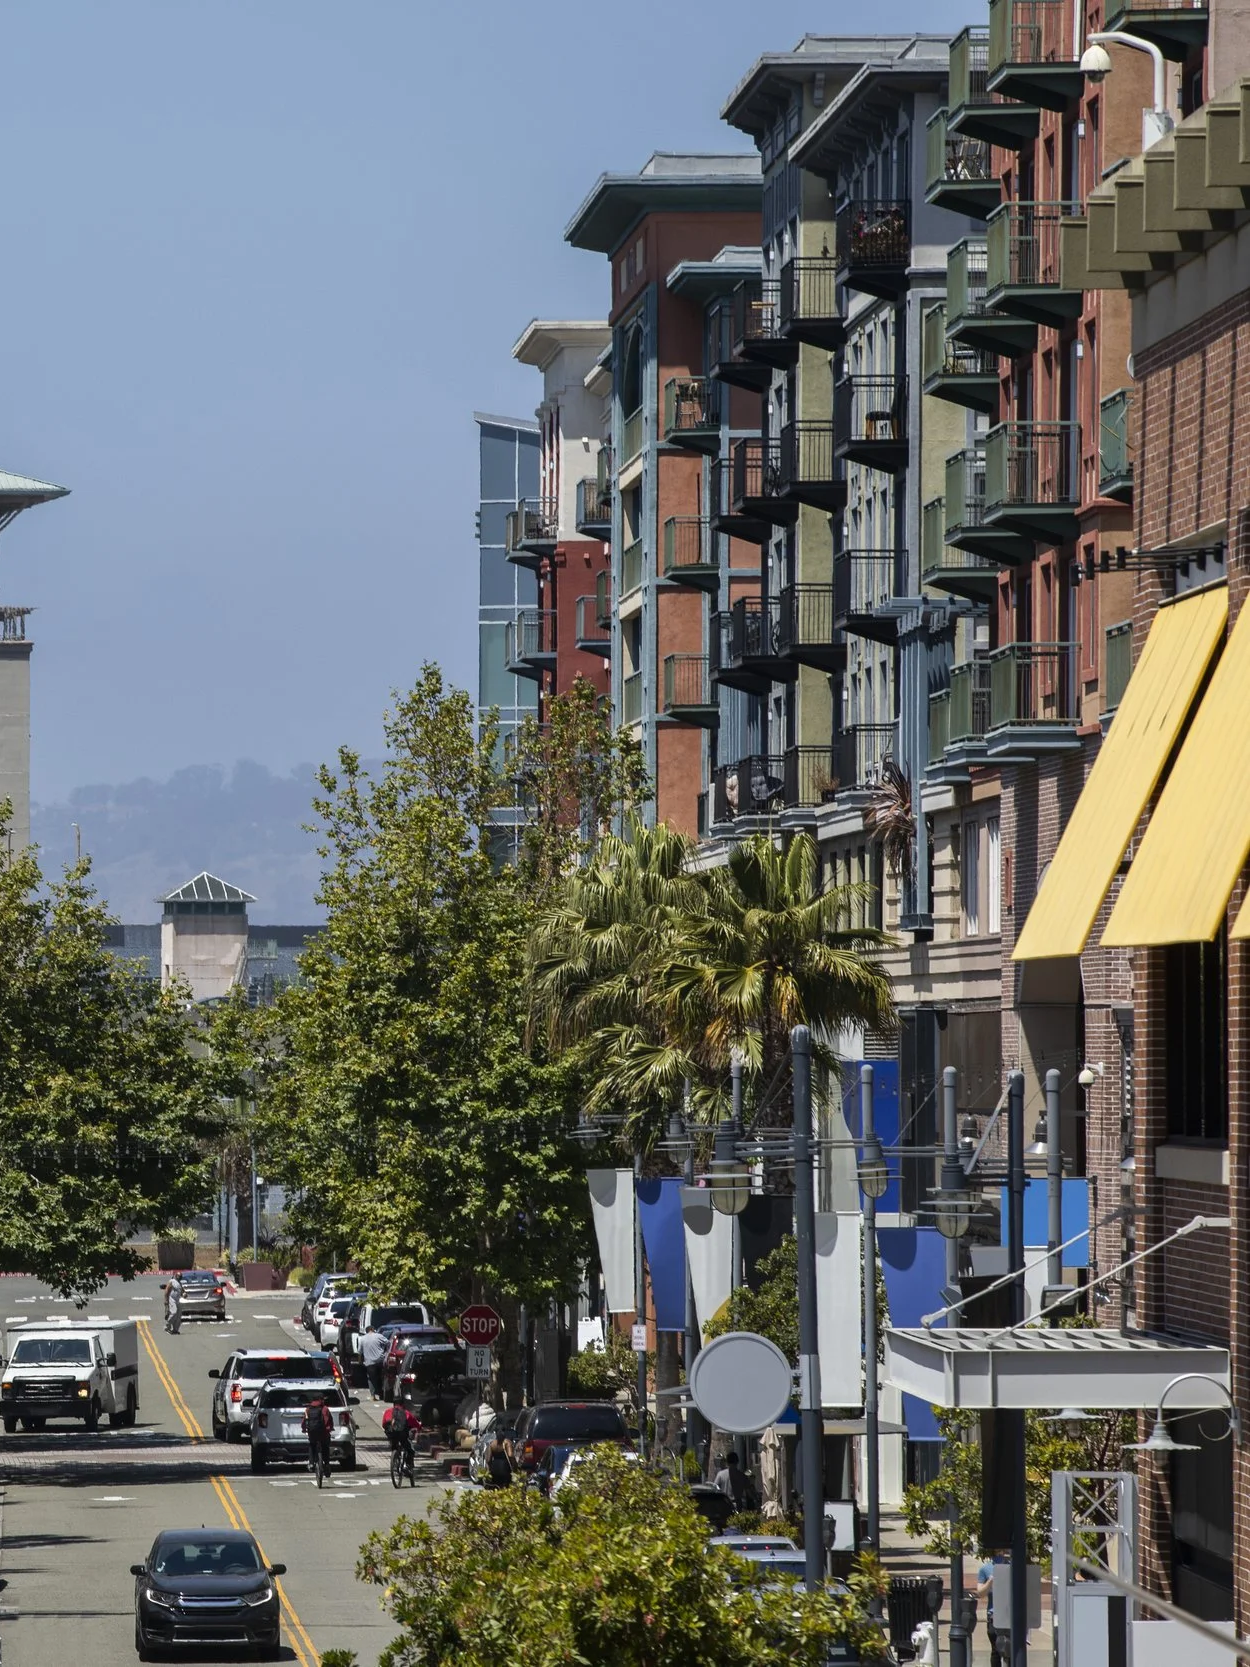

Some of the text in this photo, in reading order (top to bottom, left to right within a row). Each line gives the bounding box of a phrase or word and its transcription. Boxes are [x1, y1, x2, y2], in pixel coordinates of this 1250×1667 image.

[462, 1317, 497, 1333] STOP
[475, 1357, 483, 1367] U
[470, 1368, 489, 1376] TURN
